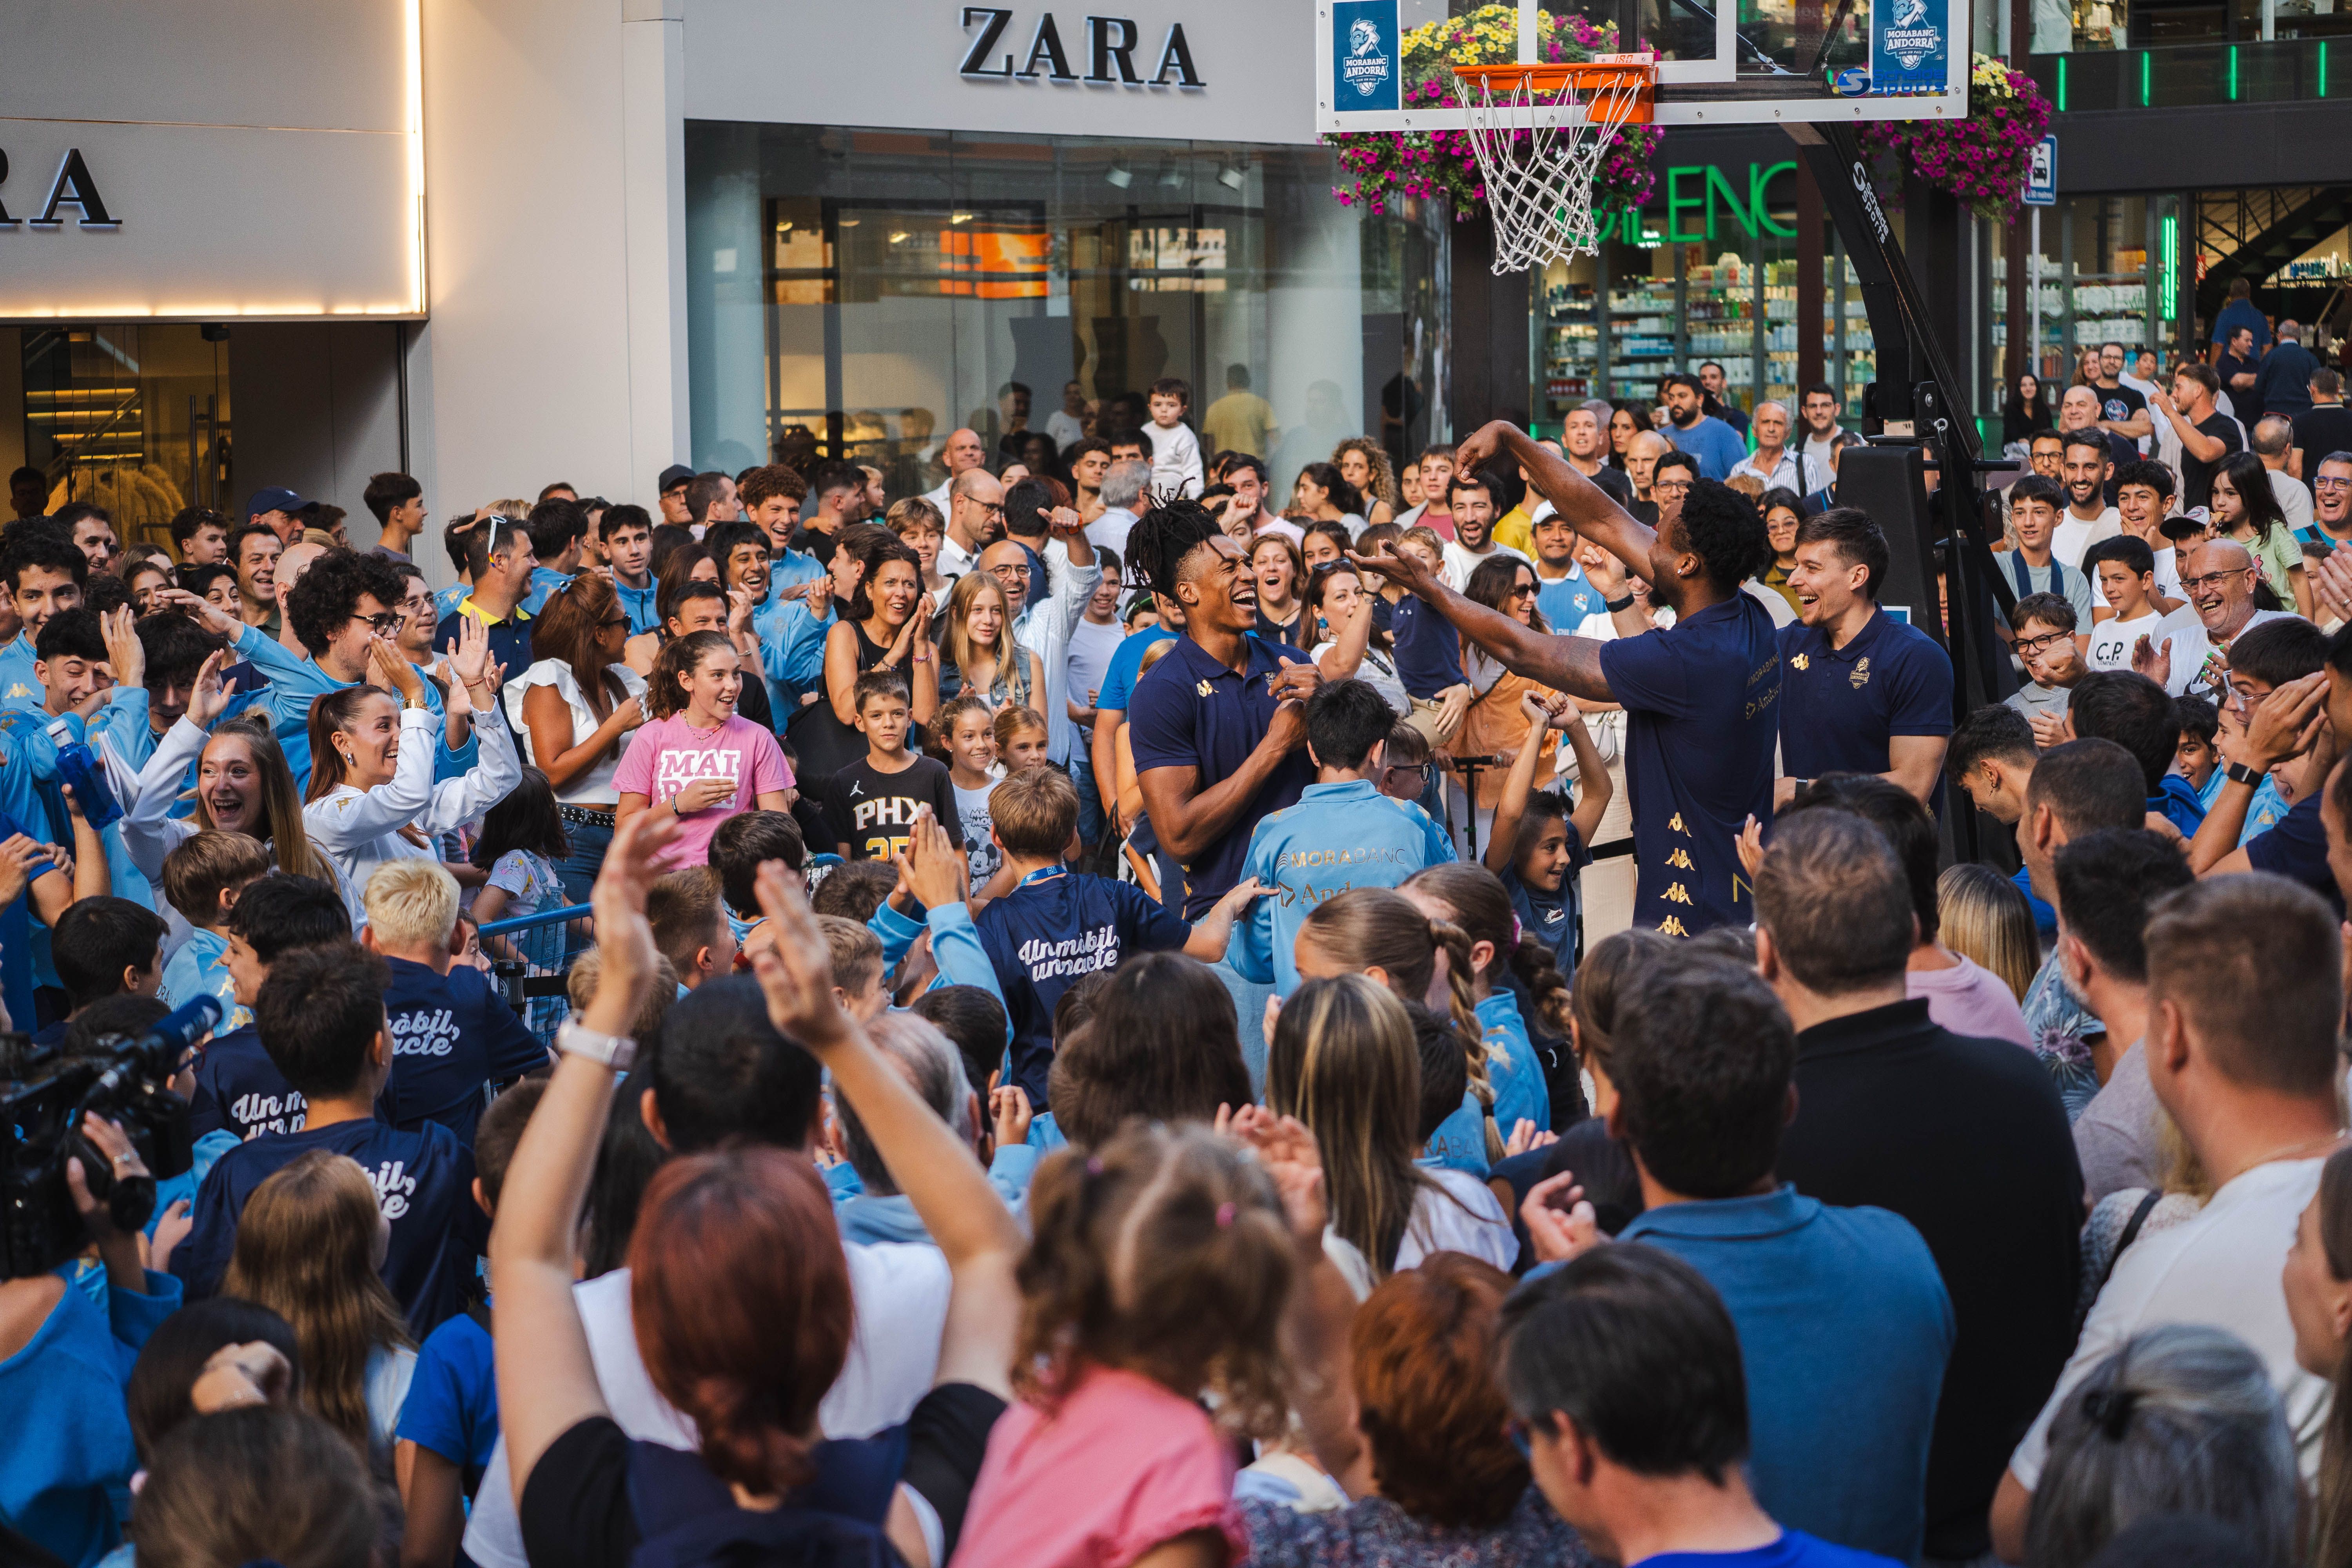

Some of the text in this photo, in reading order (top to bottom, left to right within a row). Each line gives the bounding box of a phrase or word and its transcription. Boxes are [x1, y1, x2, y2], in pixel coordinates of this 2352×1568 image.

[1887, 29, 1935, 38] MORABANC
[1887, 38, 1934, 51] ANDORRA
[960, 7, 1207, 87] ZARA
[1345, 58, 1387, 67] MORABANC
[1345, 65, 1387, 78] ANDORRA
[1872, 80, 1945, 97] Sports
[0, 148, 123, 225] A
[1862, 190, 1886, 243] Sports
[661, 753, 737, 778] MAI
[853, 796, 931, 830] PHX
[1291, 847, 1406, 868] MORABANC
[387, 1008, 460, 1041] òbil,
